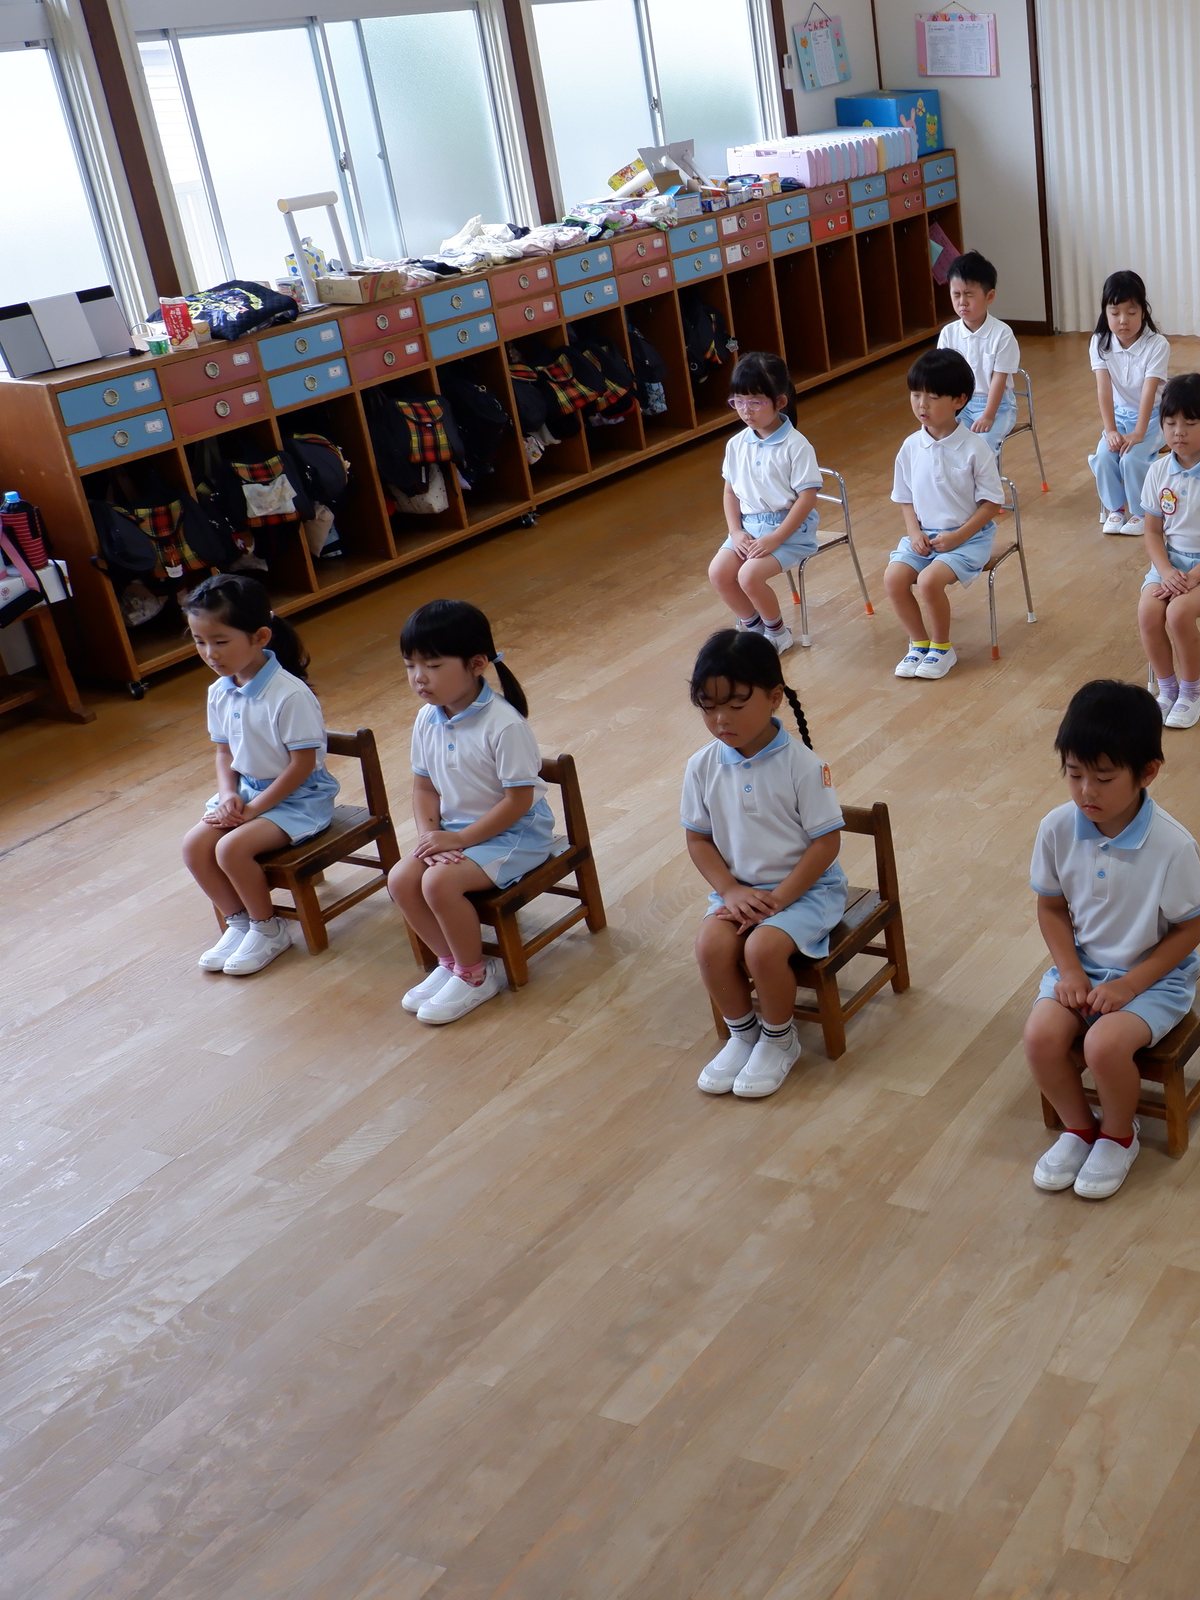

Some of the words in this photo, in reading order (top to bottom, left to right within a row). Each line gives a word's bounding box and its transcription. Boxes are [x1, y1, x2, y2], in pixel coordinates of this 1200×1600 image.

[931, 14, 976, 22] おしらせ
[808, 19, 830, 32] こんだて
